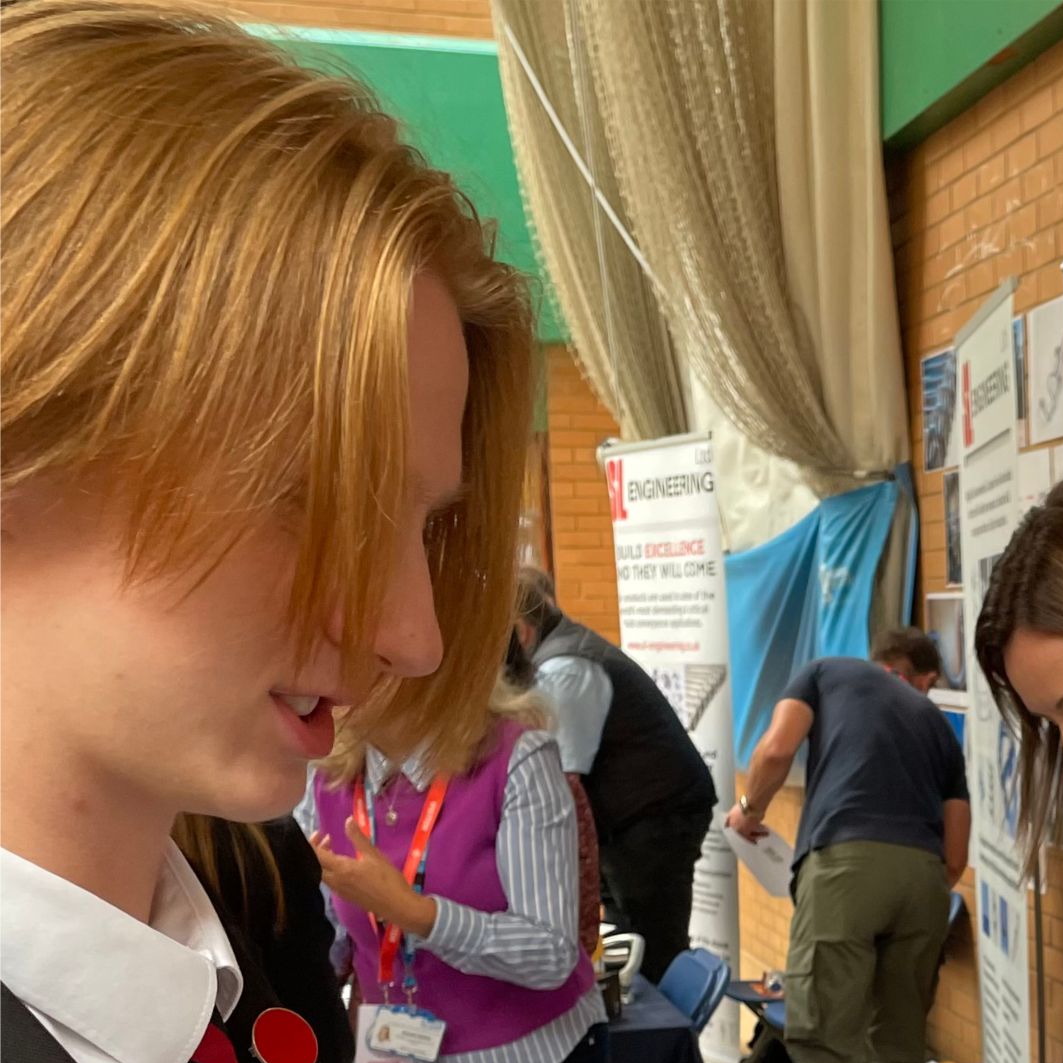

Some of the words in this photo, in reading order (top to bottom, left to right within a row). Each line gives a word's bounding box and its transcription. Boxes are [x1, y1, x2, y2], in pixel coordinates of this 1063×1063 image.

[627, 471, 714, 502] ENGINEERING
[644, 539, 704, 559] EXCELLENCE
[632, 563, 657, 581] THEY
[660, 561, 682, 580] WILL
[684, 559, 717, 578] COME
